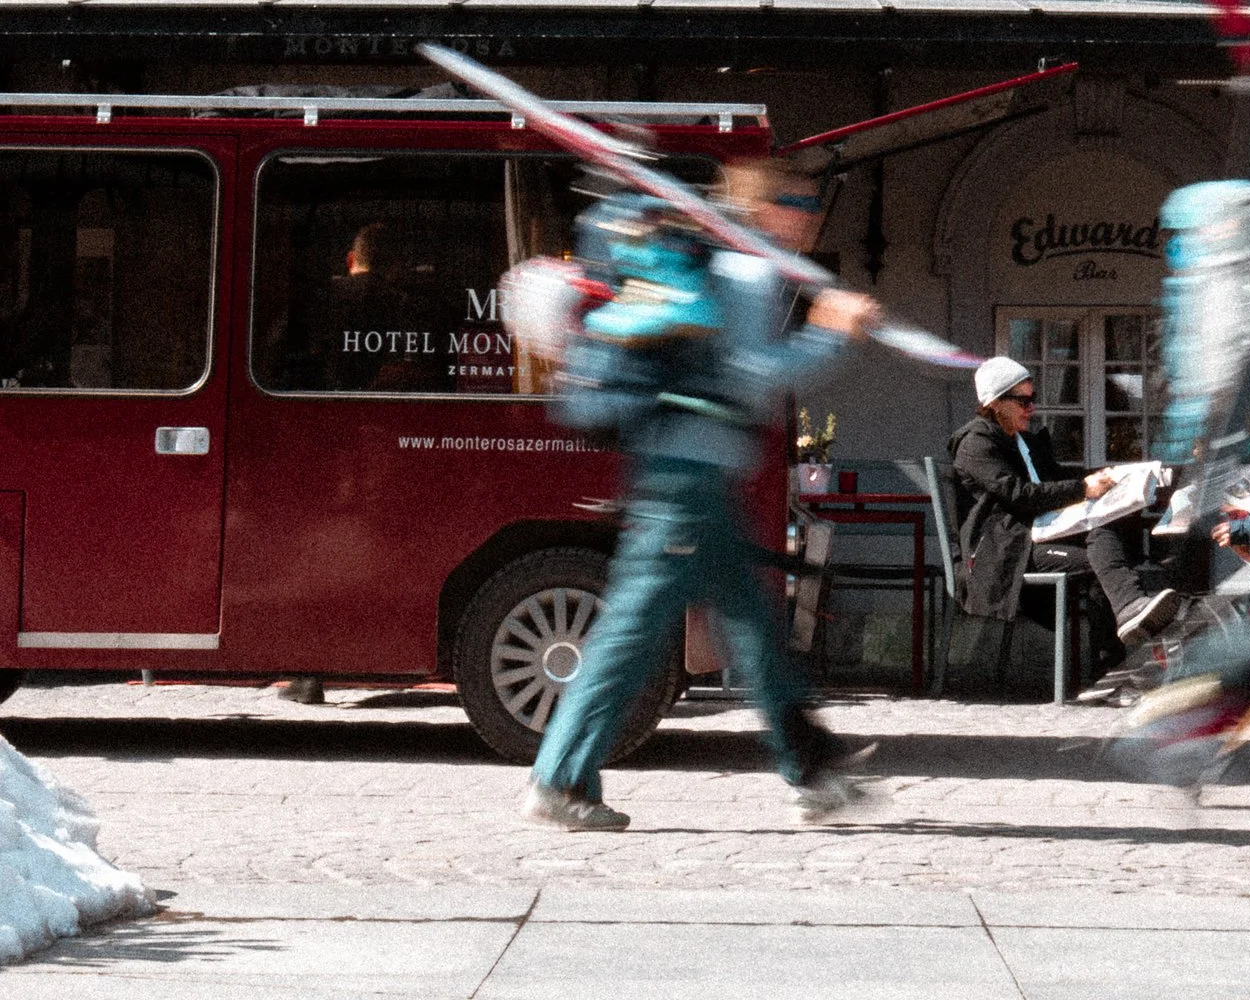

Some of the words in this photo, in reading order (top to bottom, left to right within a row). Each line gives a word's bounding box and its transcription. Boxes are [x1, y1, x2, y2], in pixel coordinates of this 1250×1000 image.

[1073, 260, 1119, 281] Bar
[343, 331, 436, 354] HOTEL
[448, 332, 514, 355] MON
